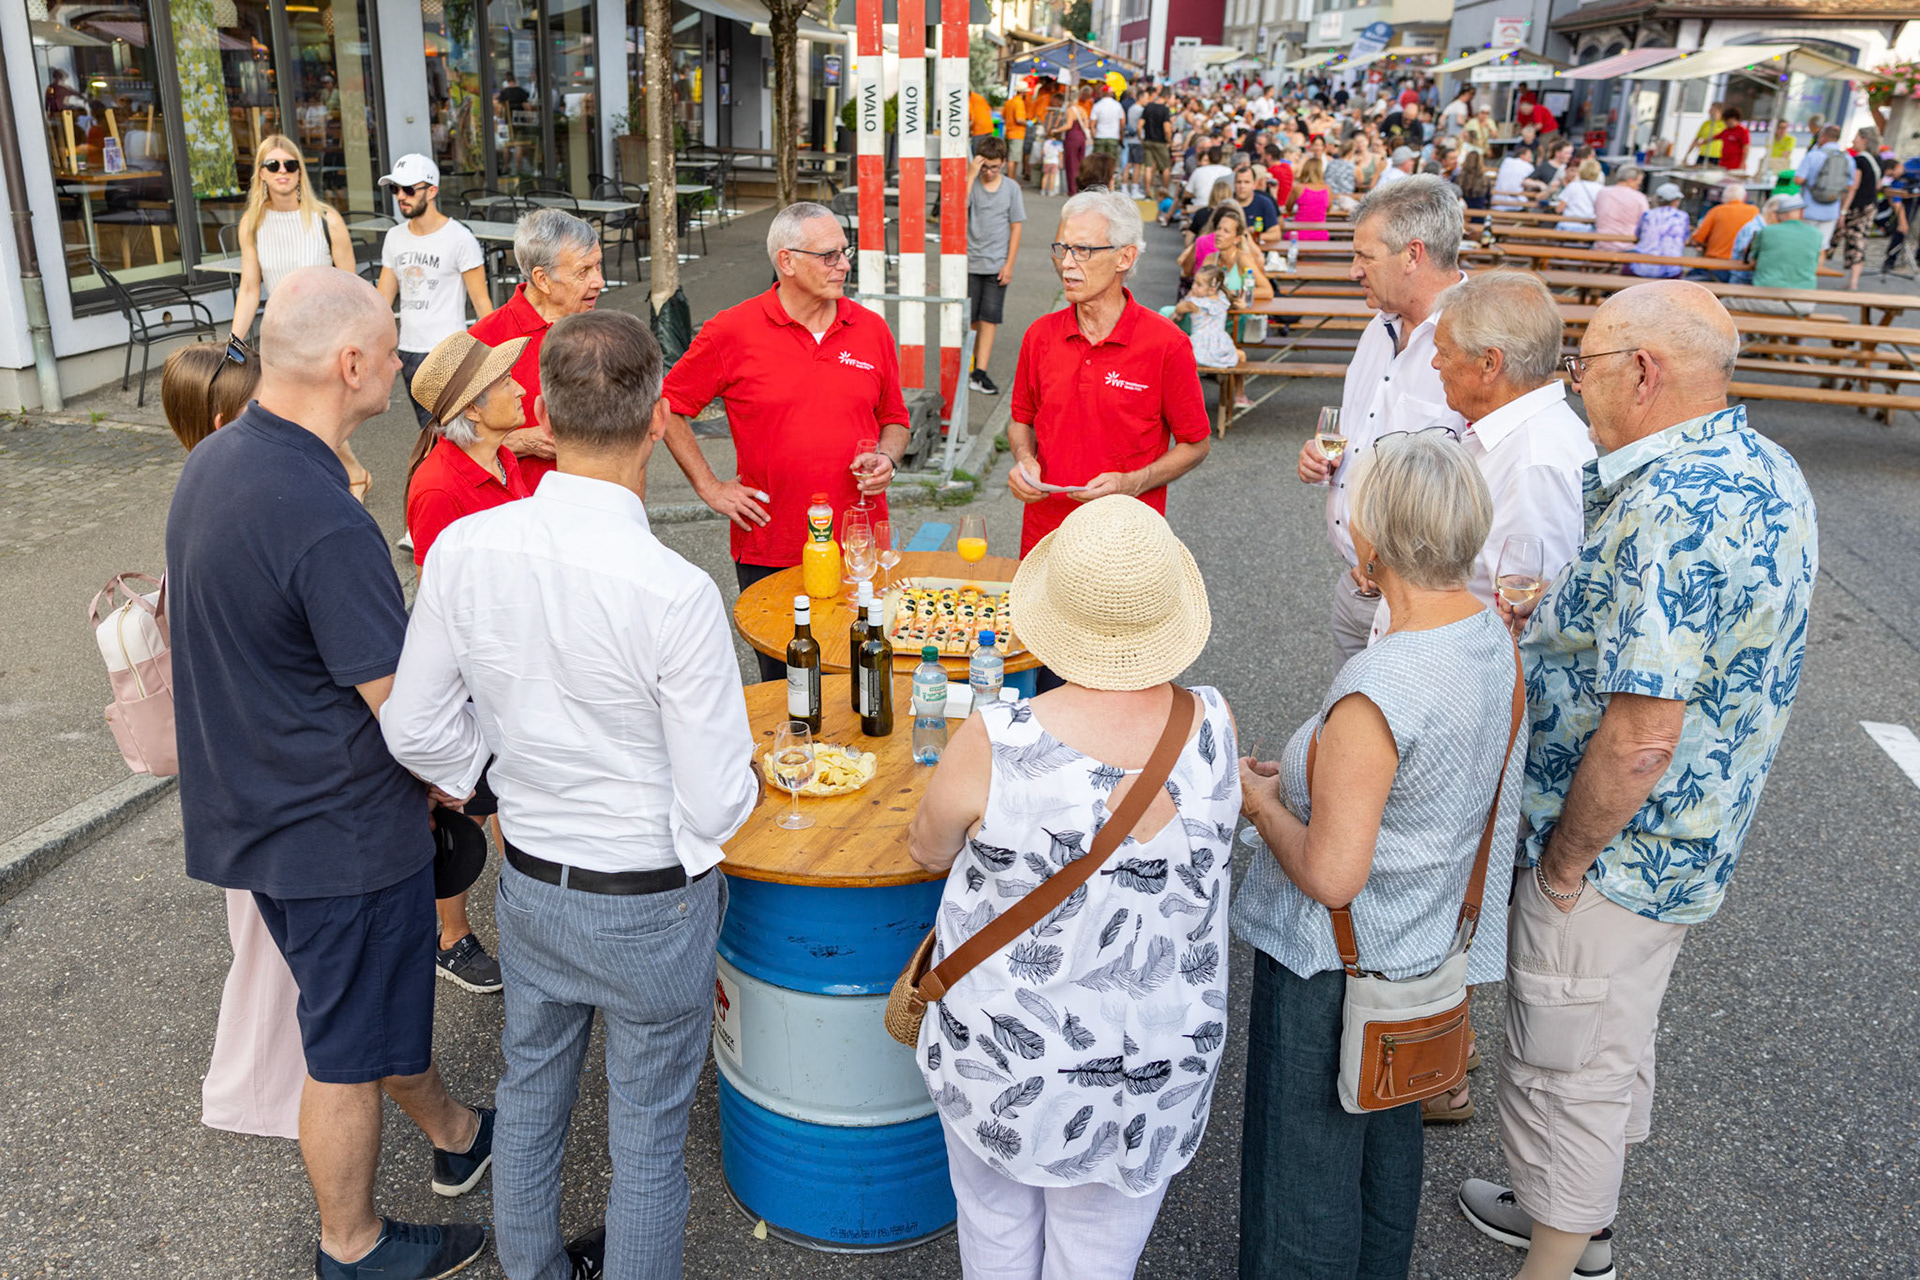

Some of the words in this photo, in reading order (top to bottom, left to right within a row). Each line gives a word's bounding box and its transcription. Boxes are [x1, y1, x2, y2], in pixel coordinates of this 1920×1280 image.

[864, 84, 876, 132] WALO
[906, 86, 918, 134] WALO
[949, 89, 961, 137] WALO
